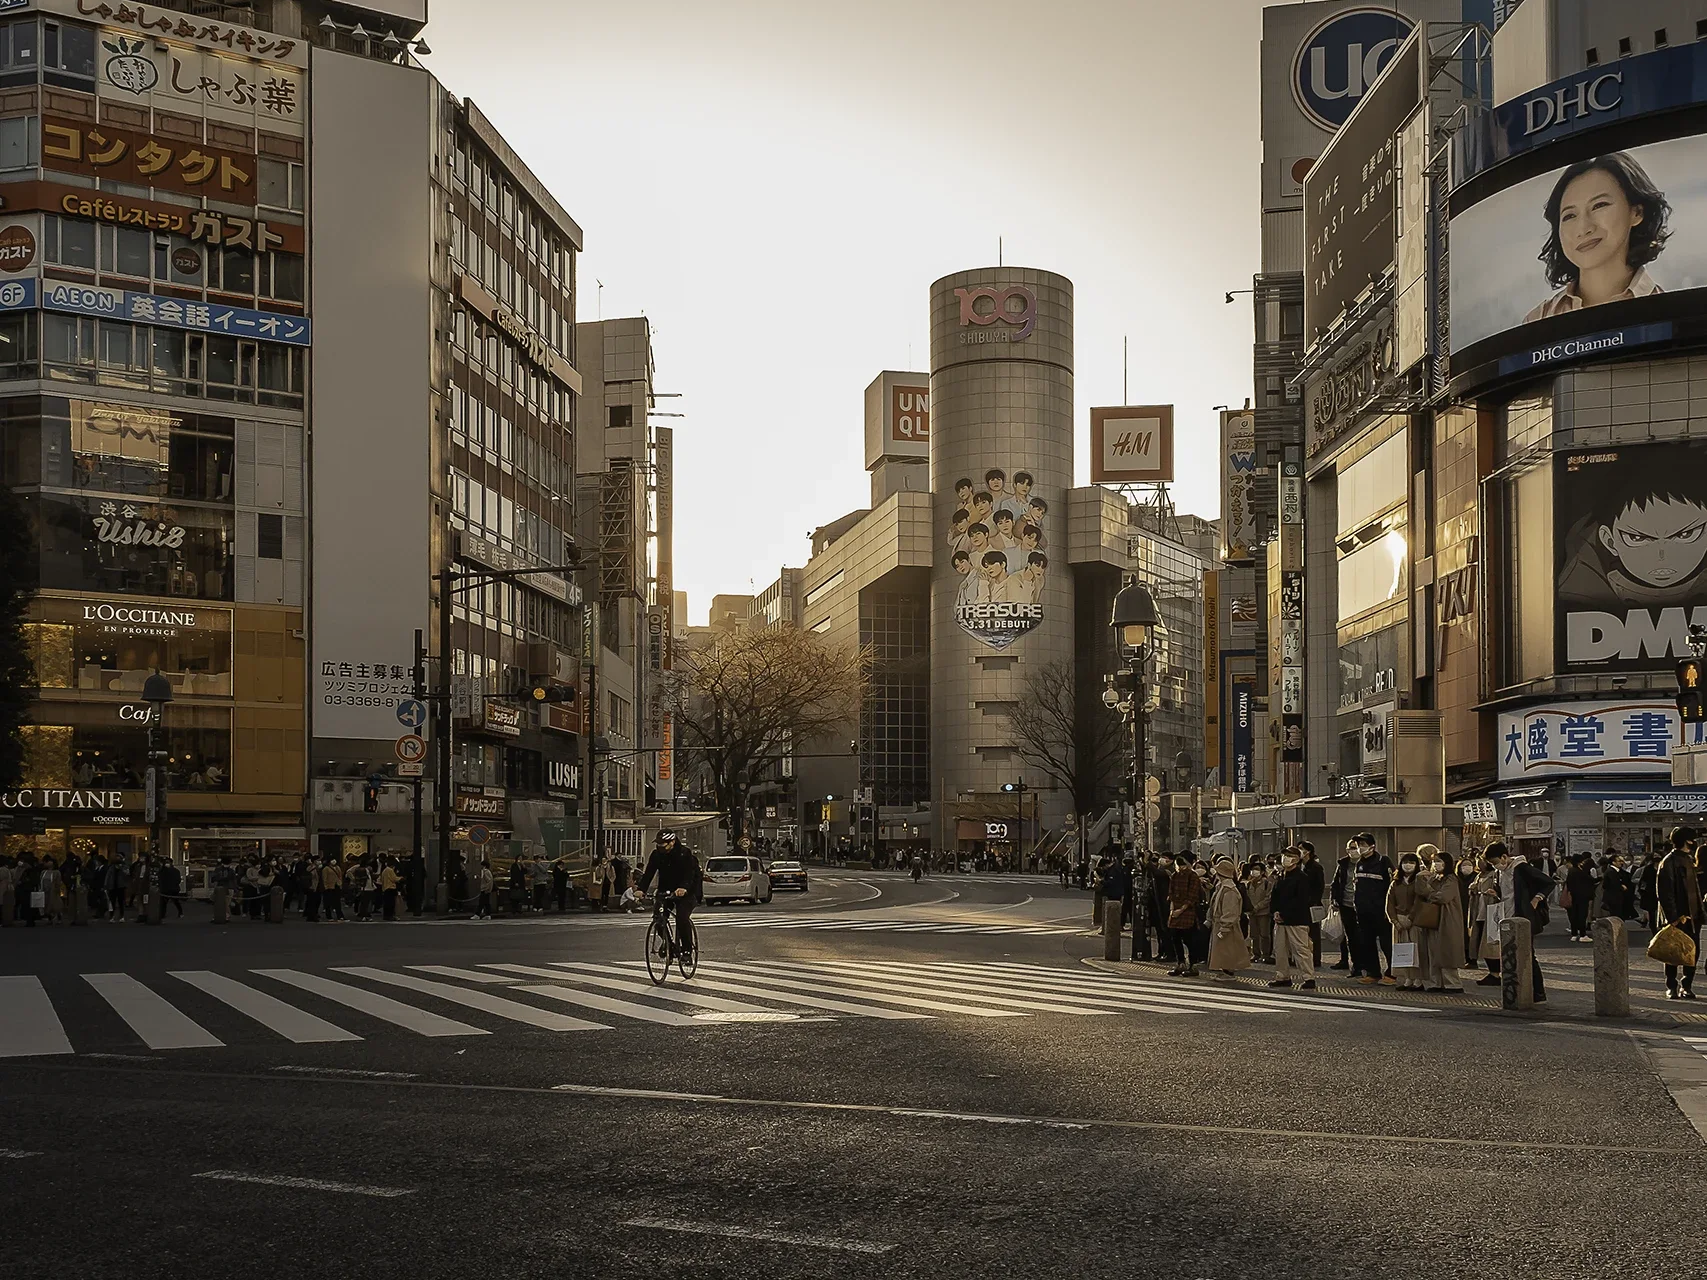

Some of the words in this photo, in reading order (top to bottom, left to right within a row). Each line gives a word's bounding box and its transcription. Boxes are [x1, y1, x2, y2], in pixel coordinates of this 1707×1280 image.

[171, 57, 296, 115] しゃぶ葉
[1523, 71, 1623, 136] DHC
[44, 123, 249, 190] コンタクト
[1318, 175, 1339, 214] THE
[191, 211, 283, 252] ガスト
[1311, 205, 1345, 262] FIRST
[1314, 250, 1343, 295] TAKE
[2, 287, 21, 303] 6F
[53, 285, 114, 312] AEON
[131, 296, 305, 339] 英会話イーオン
[954, 285, 1037, 342] 109
[959, 330, 1008, 344] SHIBUYA
[1532, 345, 1562, 365] DHC
[1564, 333, 1624, 356] Channel
[1112, 431, 1152, 457] H&M
[100, 501, 138, 519] 渋谷
[569, 585, 582, 605] 4F
[83, 604, 196, 626] L'OCCITANE
[957, 601, 1042, 619] TREASURE
[104, 625, 117, 633] EN
[122, 626, 176, 636] PROVENCE
[968, 619, 992, 629] 3.31
[994, 620, 1030, 629] DEBUT!
[324, 694, 410, 708] 03-3369-81
[1239, 692, 1248, 728] MIZUHO
[549, 761, 578, 789] LUSH
[1464, 801, 1494, 820] 千里薬品
[985, 822, 1008, 838] 109
